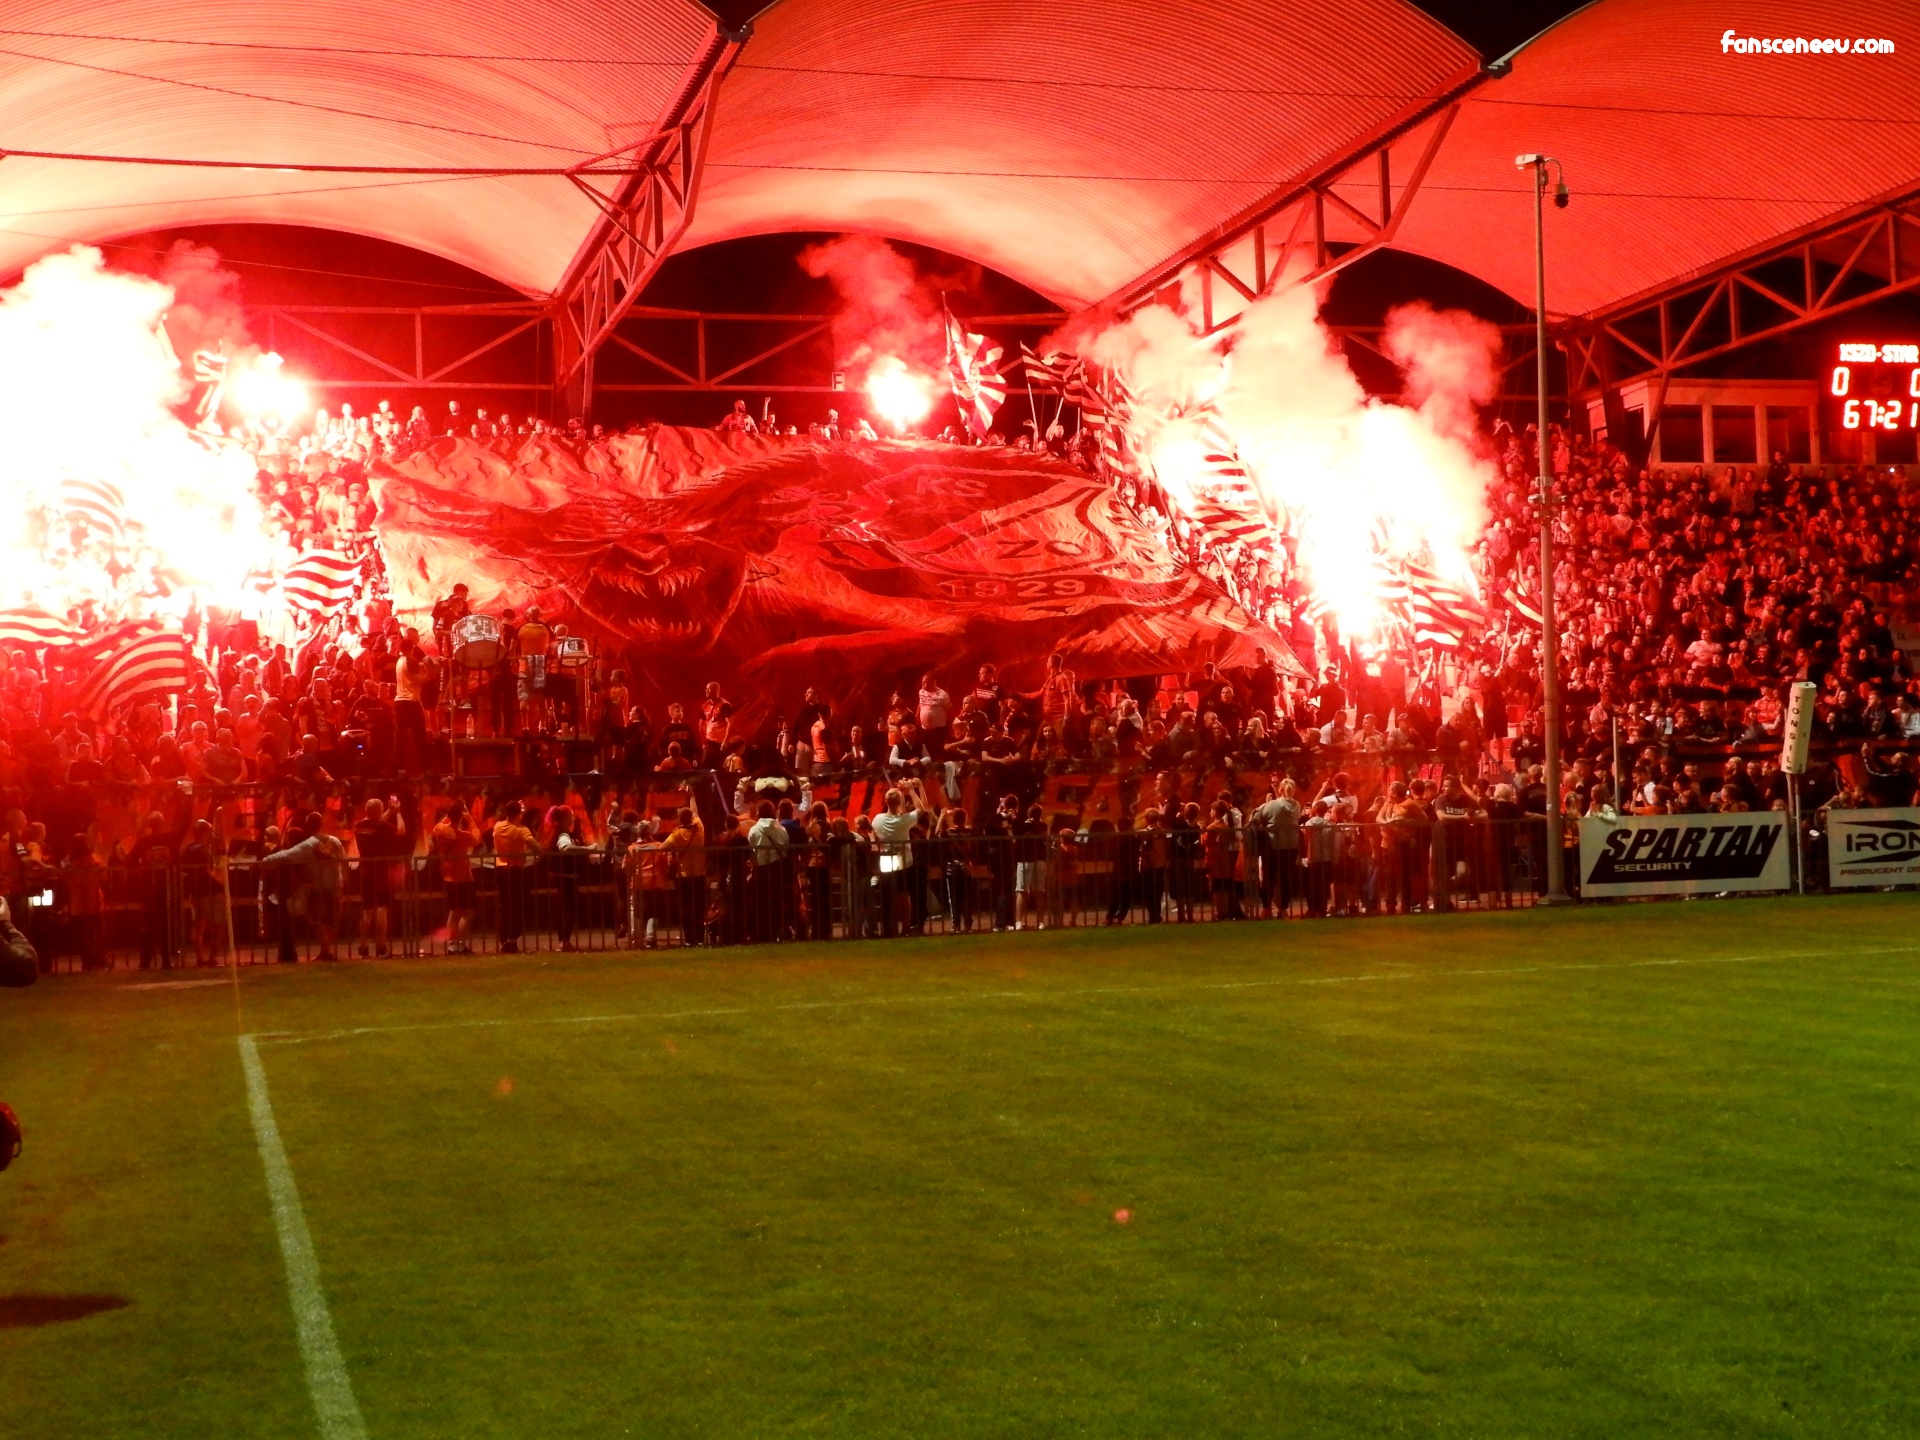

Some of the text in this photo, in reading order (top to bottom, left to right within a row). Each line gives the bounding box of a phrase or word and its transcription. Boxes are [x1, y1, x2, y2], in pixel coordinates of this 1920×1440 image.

[833, 373, 843, 390] F
[1831, 366, 1850, 396] 0
[1843, 399, 1919, 429] 67:21
[916, 474, 989, 498] KS
[936, 578, 1087, 598] 1929
[1604, 824, 1783, 861] SPARTAN
[1613, 861, 1693, 873] SECURITY
[1840, 866, 1904, 876] PRODUCENT
